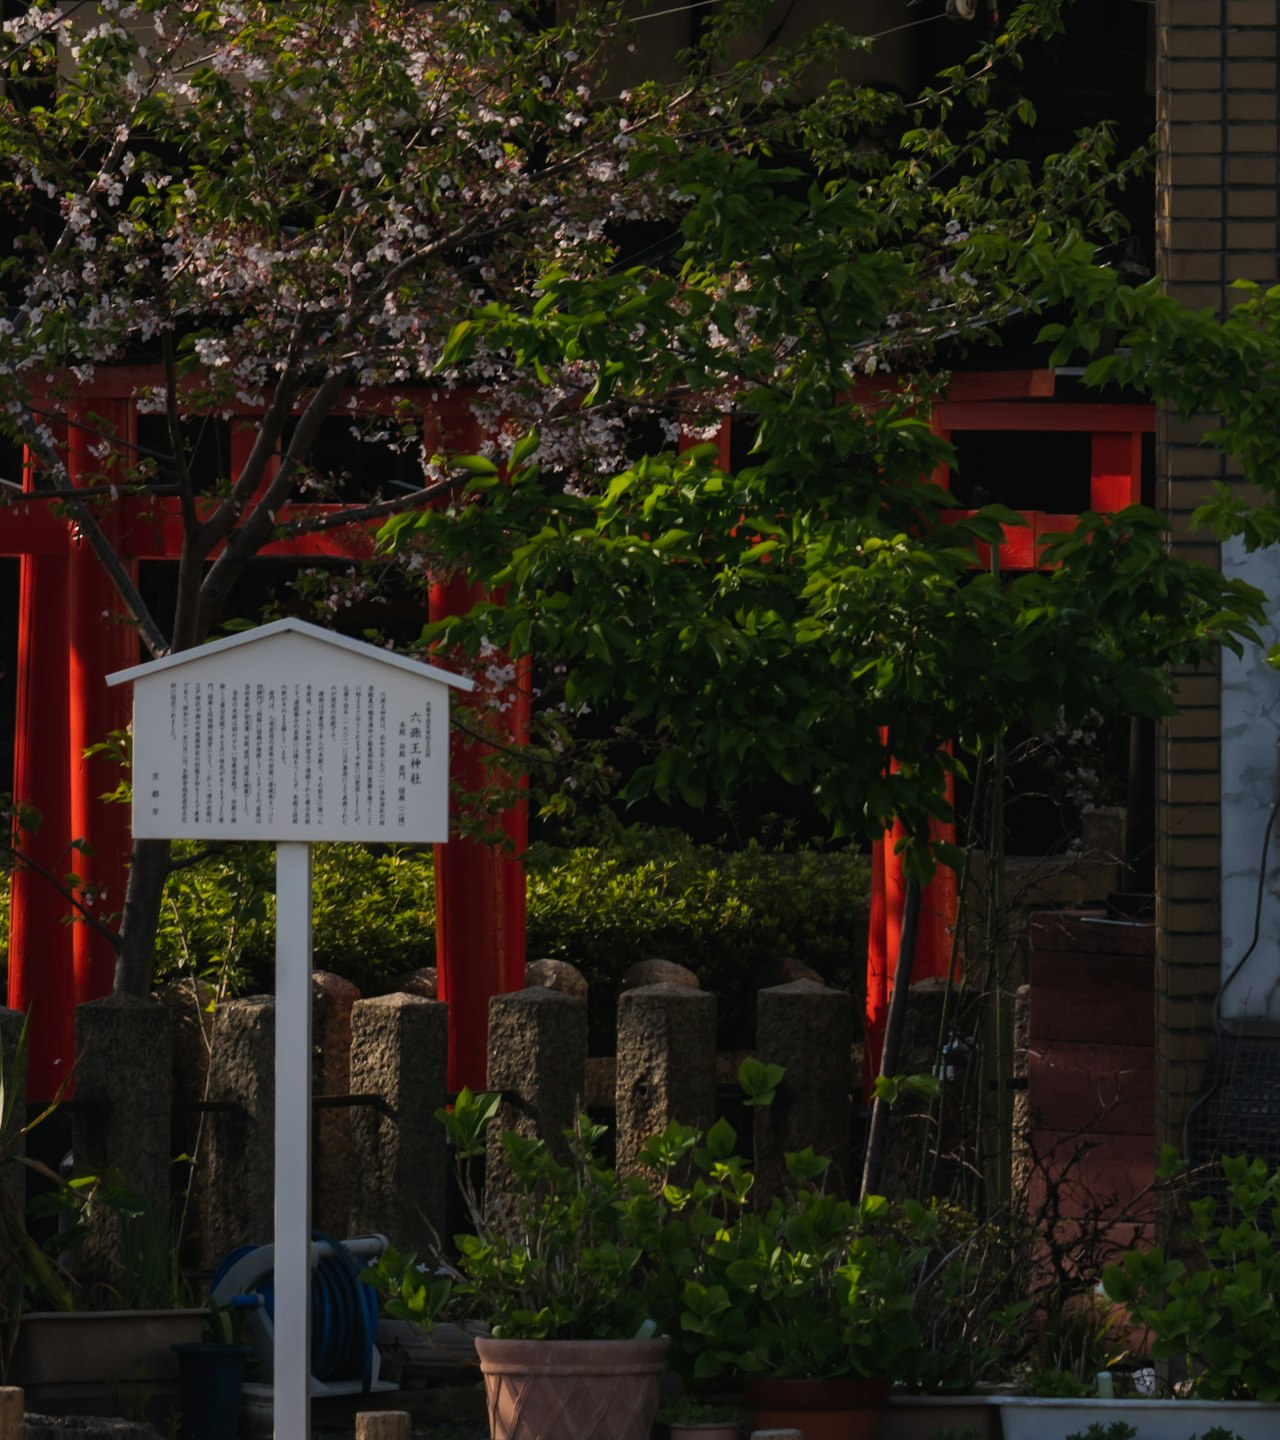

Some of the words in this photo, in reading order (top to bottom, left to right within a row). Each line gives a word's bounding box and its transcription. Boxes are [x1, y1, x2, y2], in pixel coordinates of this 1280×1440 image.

[409, 711, 422, 785] 六孫王神社
